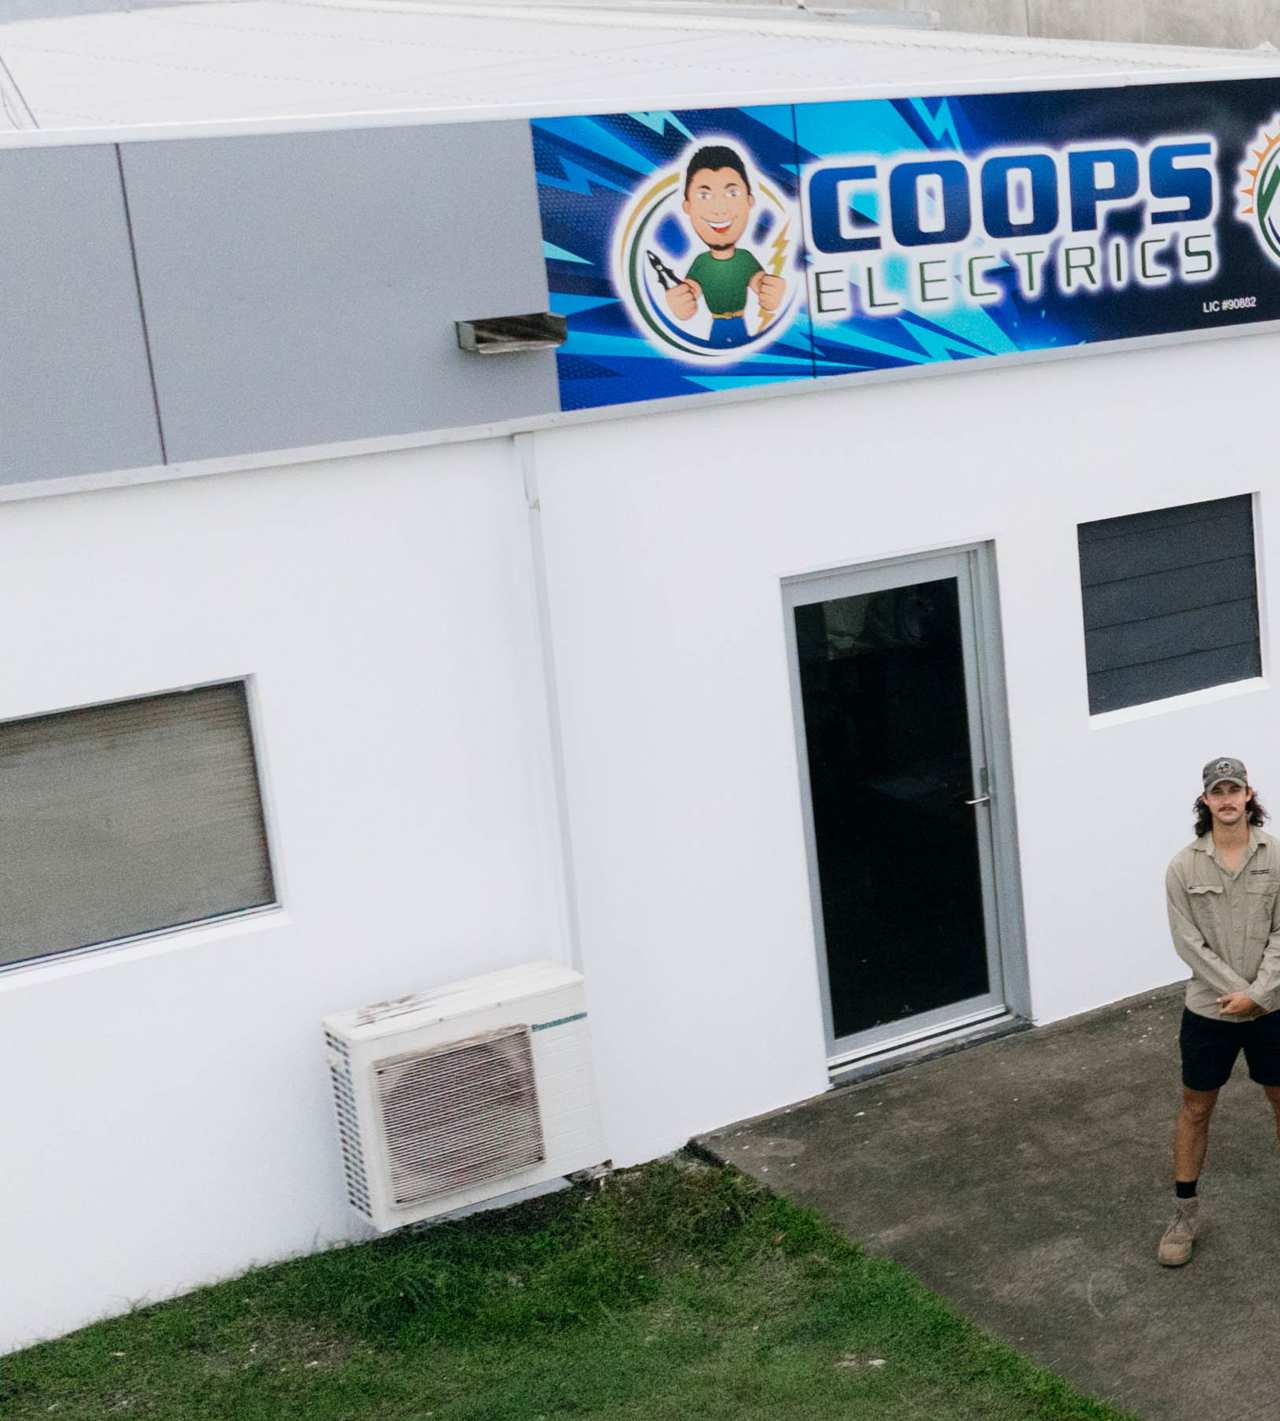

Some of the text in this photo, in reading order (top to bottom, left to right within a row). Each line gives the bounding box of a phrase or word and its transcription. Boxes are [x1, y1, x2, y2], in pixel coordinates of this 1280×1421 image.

[808, 142, 1214, 254] COOPS
[814, 234, 1214, 314] ELECTRICS
[1202, 300, 1220, 313] LIC
